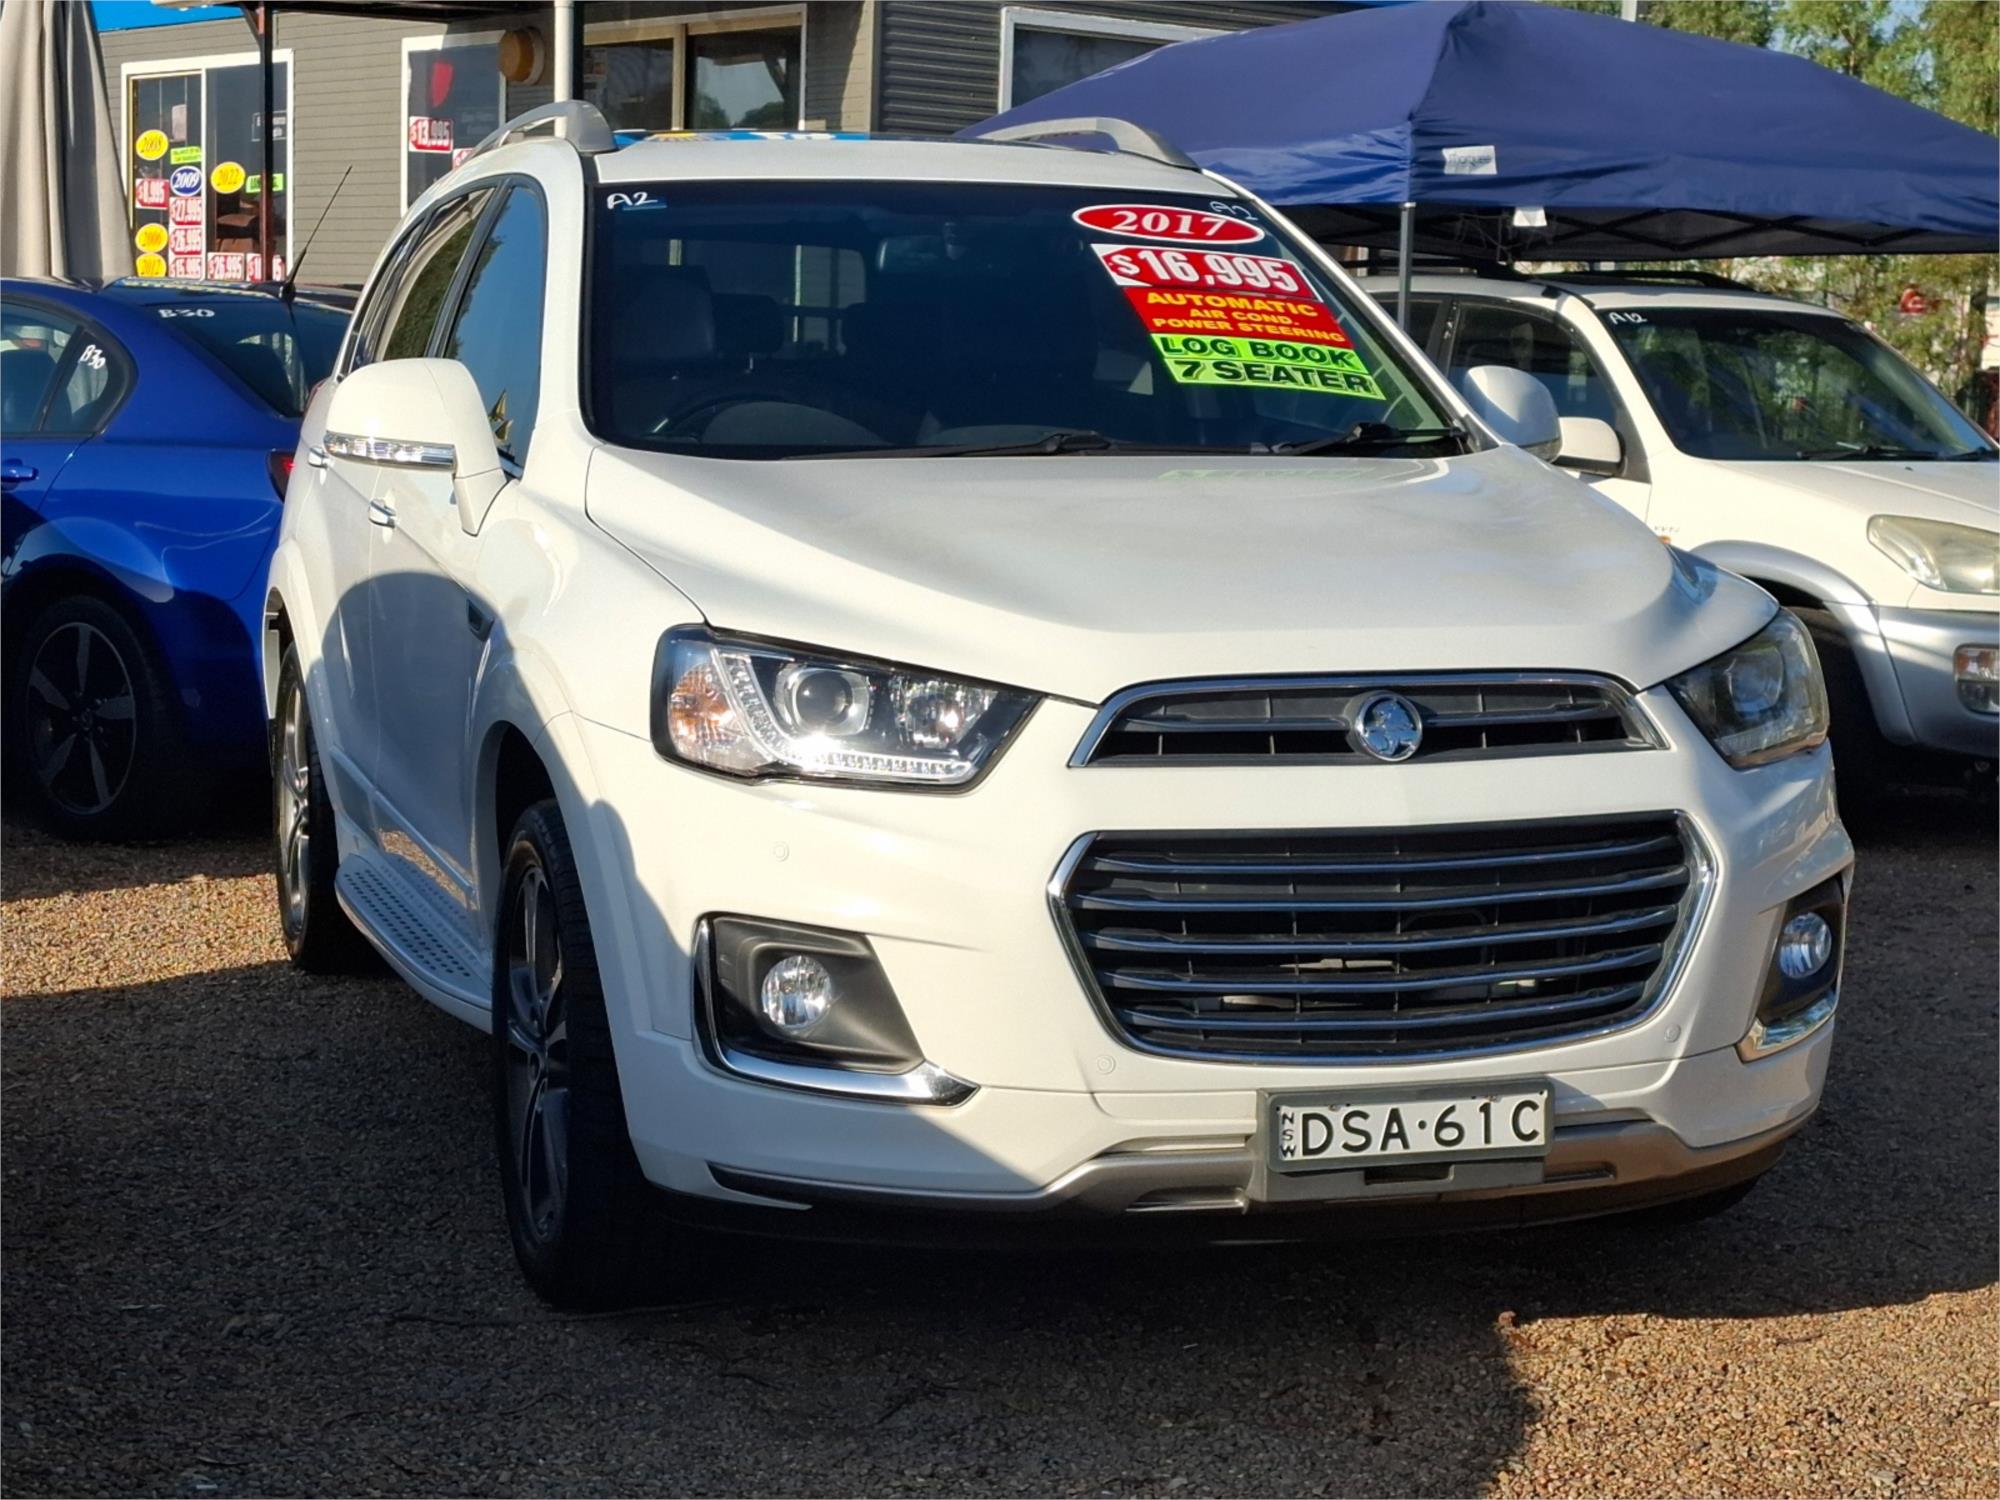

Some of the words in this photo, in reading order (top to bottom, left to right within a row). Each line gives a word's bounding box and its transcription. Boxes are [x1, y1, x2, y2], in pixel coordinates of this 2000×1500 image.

[173, 171, 201, 189] 2009
[1112, 210, 1228, 237] 2017
[1110, 249, 1300, 293] $16,995
[158, 308, 216, 319] B30
[1146, 292, 1319, 317] AUTOMATIC
[1189, 308, 1229, 320] AIR
[1233, 311, 1301, 326] COND.
[1152, 318, 1234, 331] POWER
[1237, 323, 1346, 343] STEERING
[78, 344, 106, 370] B30
[1161, 336, 1239, 356] LOG
[1248, 340, 1360, 369] BOOK
[1173, 360, 1207, 379] 7
[1212, 360, 1373, 393] SEATER
[1280, 1111, 1298, 1159] NSW
